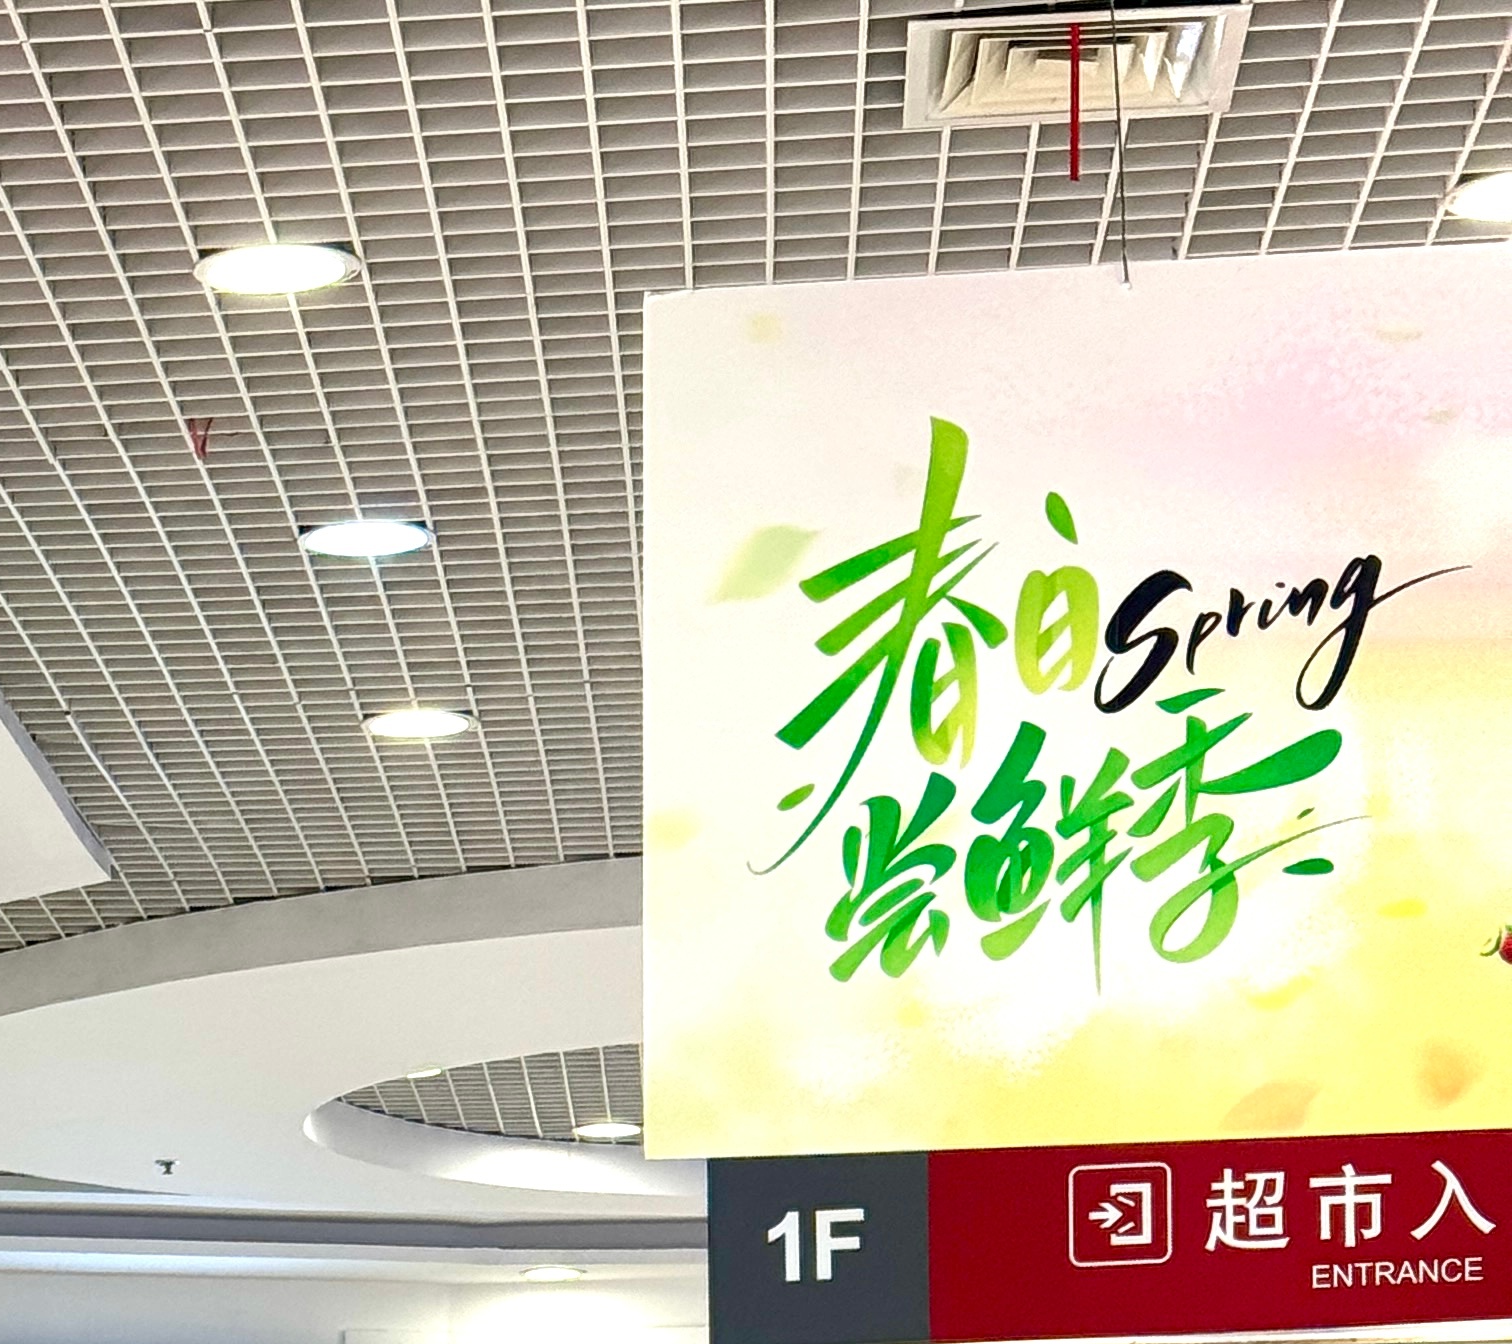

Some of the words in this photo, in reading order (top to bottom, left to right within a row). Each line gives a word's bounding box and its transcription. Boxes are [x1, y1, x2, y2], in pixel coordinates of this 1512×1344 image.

[748, 416, 1099, 873] 春日
[1094, 553, 1471, 711] Spring
[824, 688, 1371, 996] 尝鲜季
[767, 1208, 865, 1283] 1F
[1205, 1160, 1496, 1251] 超市入
[1311, 1256, 1483, 1289] ENTRANCE
